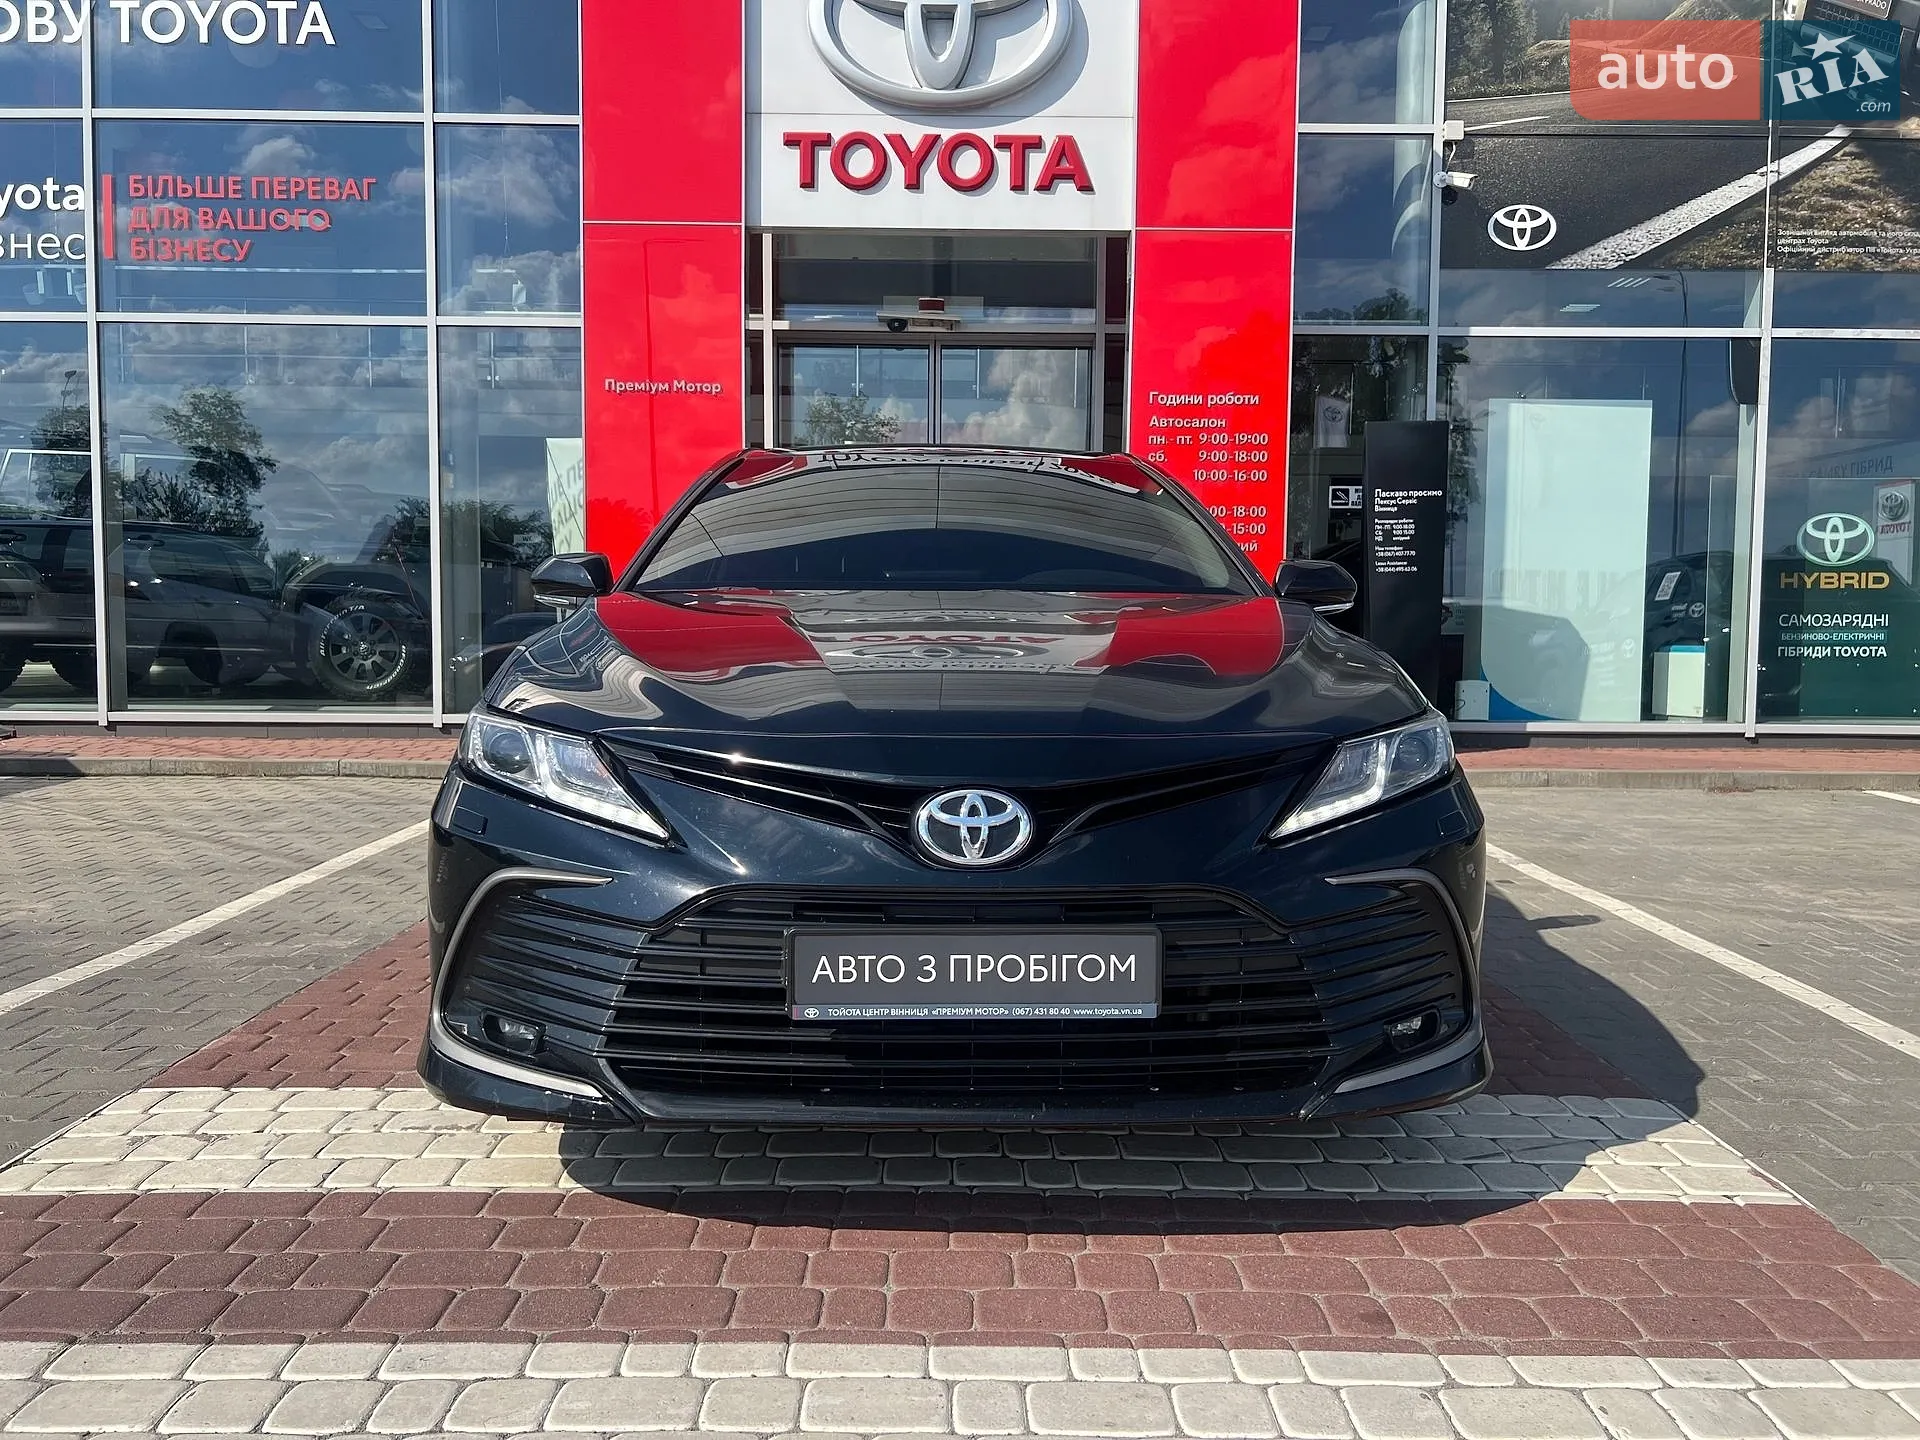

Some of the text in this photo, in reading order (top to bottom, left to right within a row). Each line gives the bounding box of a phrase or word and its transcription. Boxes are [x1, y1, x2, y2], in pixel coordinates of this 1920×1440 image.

[109, 0, 336, 45] TOYOTA
[783, 131, 1095, 192] TOYOTA
[129, 175, 377, 200] БІЛЬШЕ ПЕРЕВАГ
[128, 206, 331, 233] ДЛЯ ВАШОГО
[0, 232, 87, 260] нес
[130, 237, 252, 263] БІЗНЕСУ
[604, 378, 721, 396] Преміум Мотор
[1149, 392, 1260, 408] Години роботи
[1149, 415, 1226, 428] Автосалон
[1176, 434, 1193, 445] пт.
[1199, 433, 1269, 445] 9:00-19:00
[1148, 450, 1268, 463] сб. 9:00-18:00
[1193, 469, 1268, 482] 10:00-16:00
[1780, 572, 1890, 589] HYBRID
[1779, 613, 1889, 629] САМОЗАРЯДНІ
[1781, 632, 1885, 641] БЕНЗИНОВО-ЕЛЕКТРИЧНІ
[1777, 646, 1888, 659] ГІБРИДИ TOYOTA
[811, 954, 906, 984] АВТО
[949, 953, 1137, 983] ПРОБІГОМ
[828, 1007, 1143, 1018] ТОЙОТА ЦЕНТР ВІННИЦЯ «ПРЕМІУМ МОТОР» (067) 431 80 40 www.toyota.vn.ua
